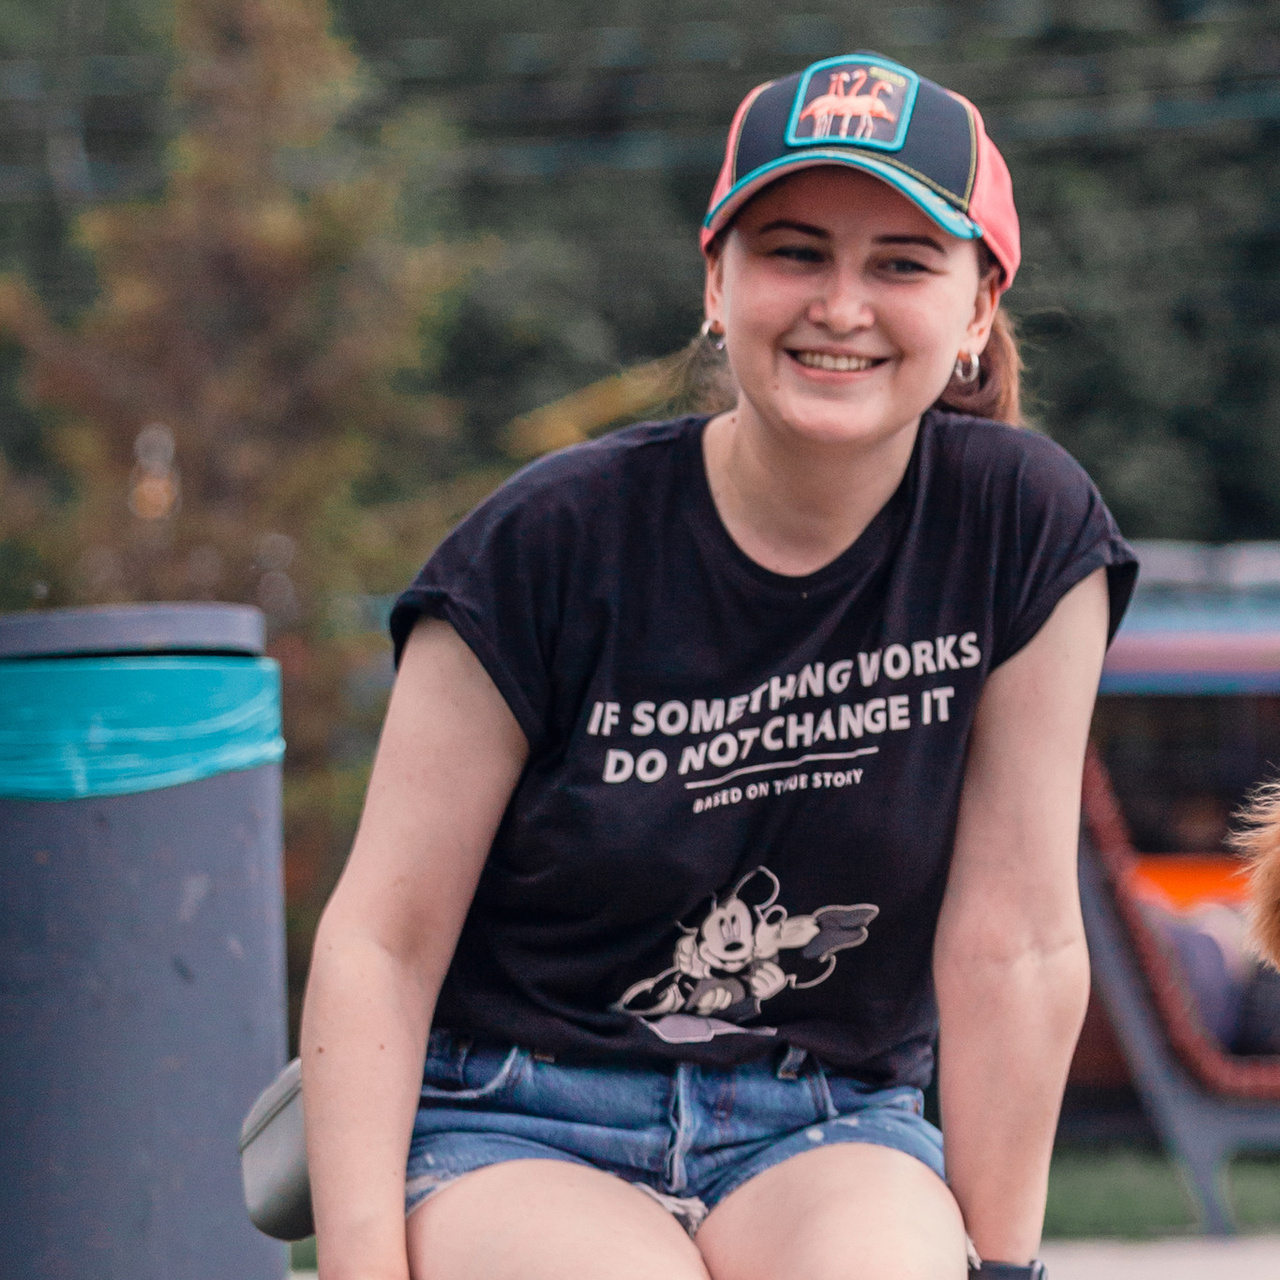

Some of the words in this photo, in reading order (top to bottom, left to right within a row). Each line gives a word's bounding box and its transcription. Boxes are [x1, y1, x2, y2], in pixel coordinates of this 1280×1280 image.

[587, 701, 621, 736] IF
[630, 659, 854, 737] SOMETHNG
[602, 748, 668, 784] DO
[678, 726, 761, 776] NOT
[761, 694, 910, 751] CHANGE
[921, 686, 955, 726] IT
[692, 786, 742, 814] BASED
[745, 781, 770, 800] ON
